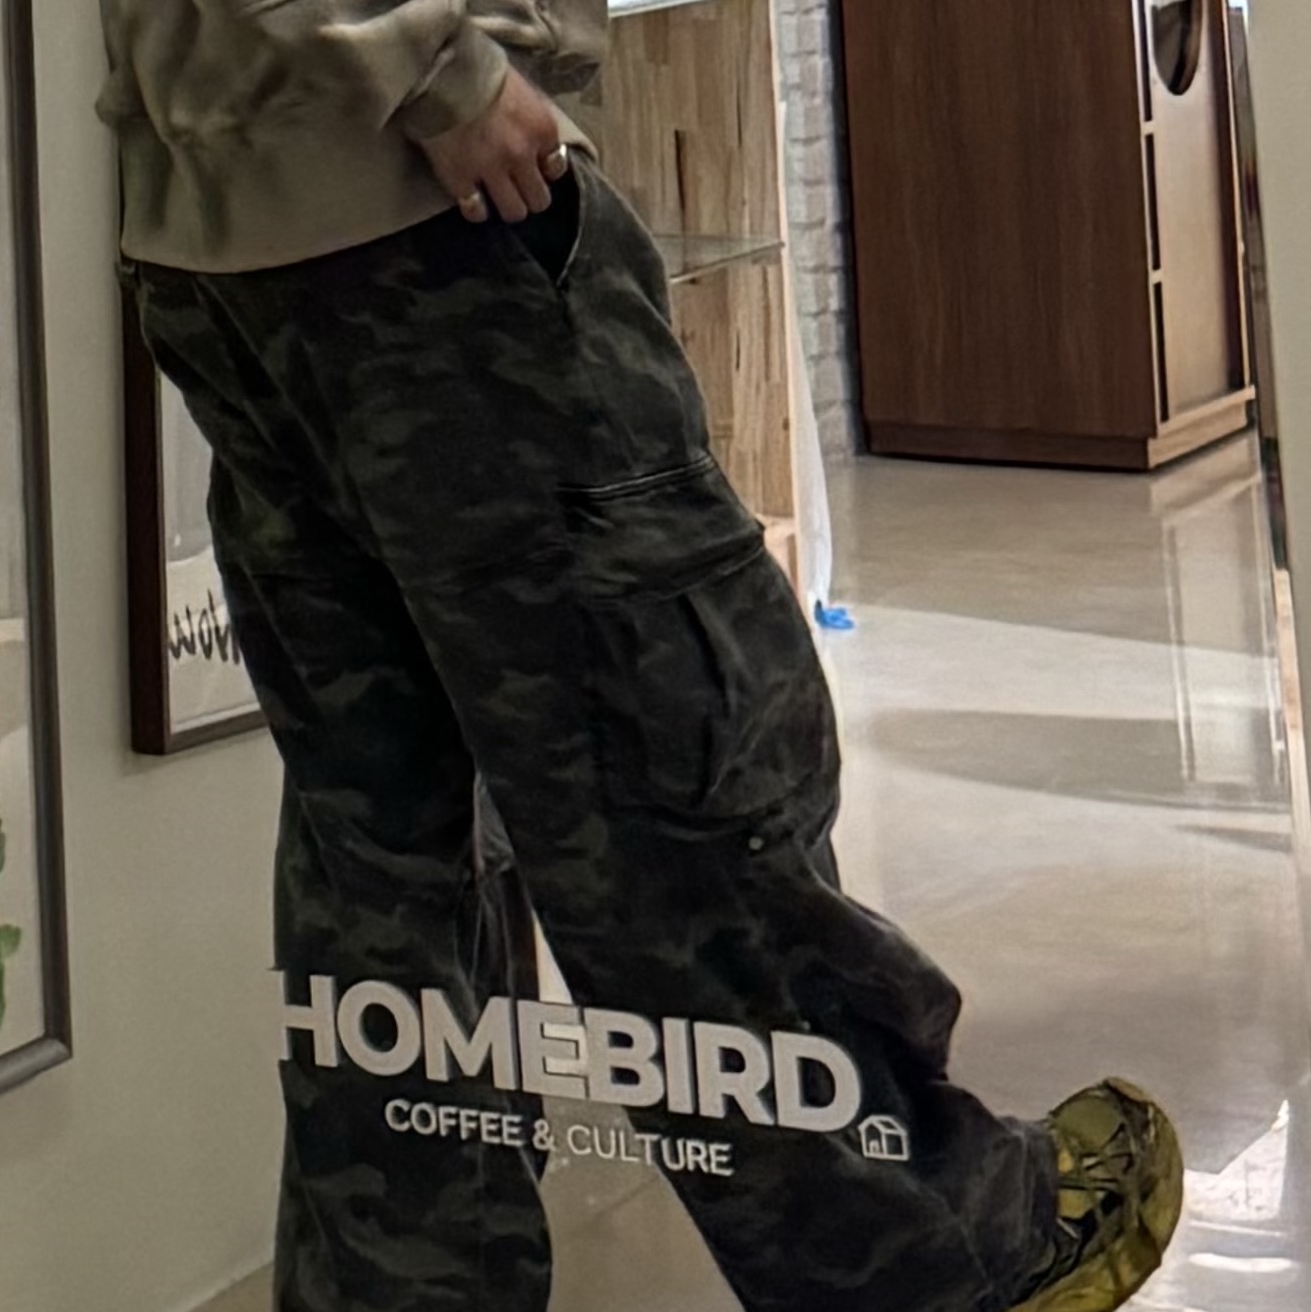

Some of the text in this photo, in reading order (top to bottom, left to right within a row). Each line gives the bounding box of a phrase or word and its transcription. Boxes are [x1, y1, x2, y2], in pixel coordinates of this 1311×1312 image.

[266, 968, 861, 1133] HOMEBIRD
[385, 1098, 735, 1177] COFFEE & CULTURE
